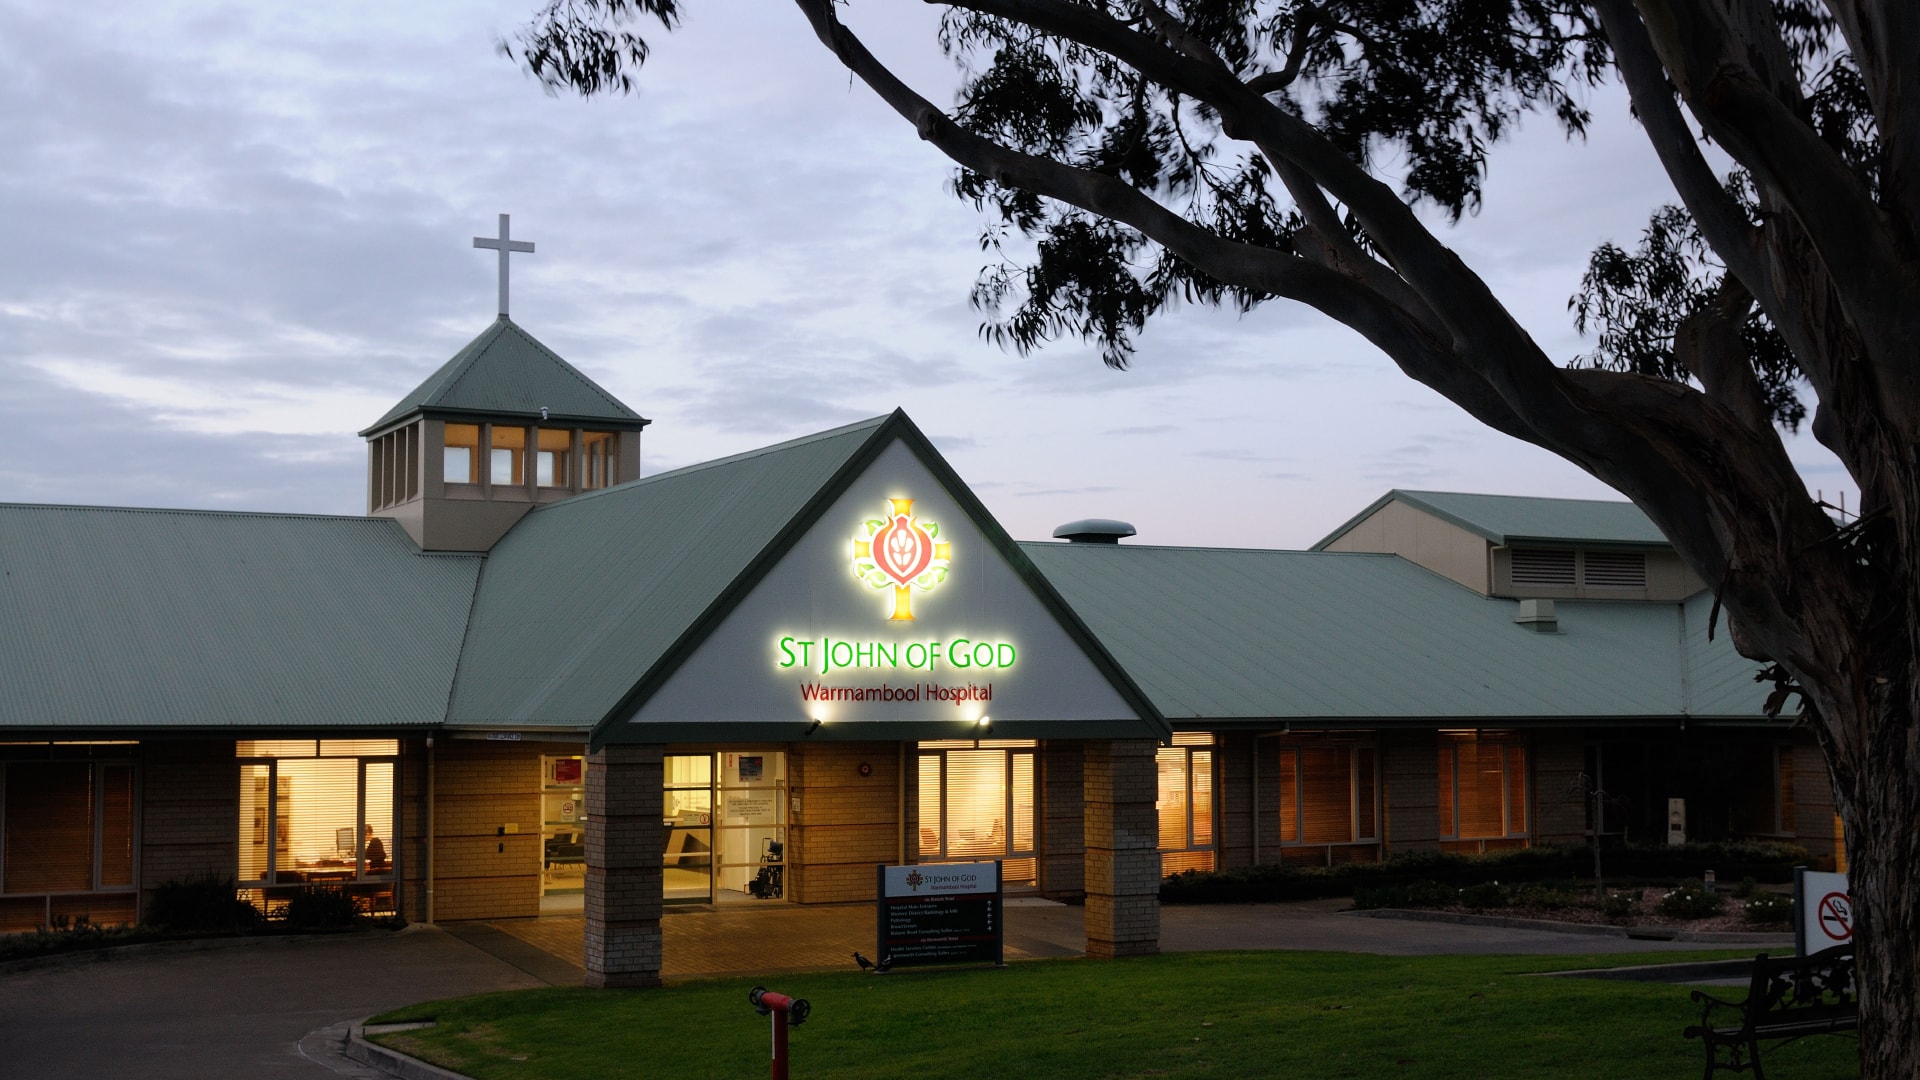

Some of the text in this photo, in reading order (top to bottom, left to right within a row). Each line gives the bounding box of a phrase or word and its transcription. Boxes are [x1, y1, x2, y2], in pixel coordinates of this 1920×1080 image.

[779, 637, 1016, 674] ST JOHN OF GOD
[800, 683, 993, 706] Warrnambool Hospital
